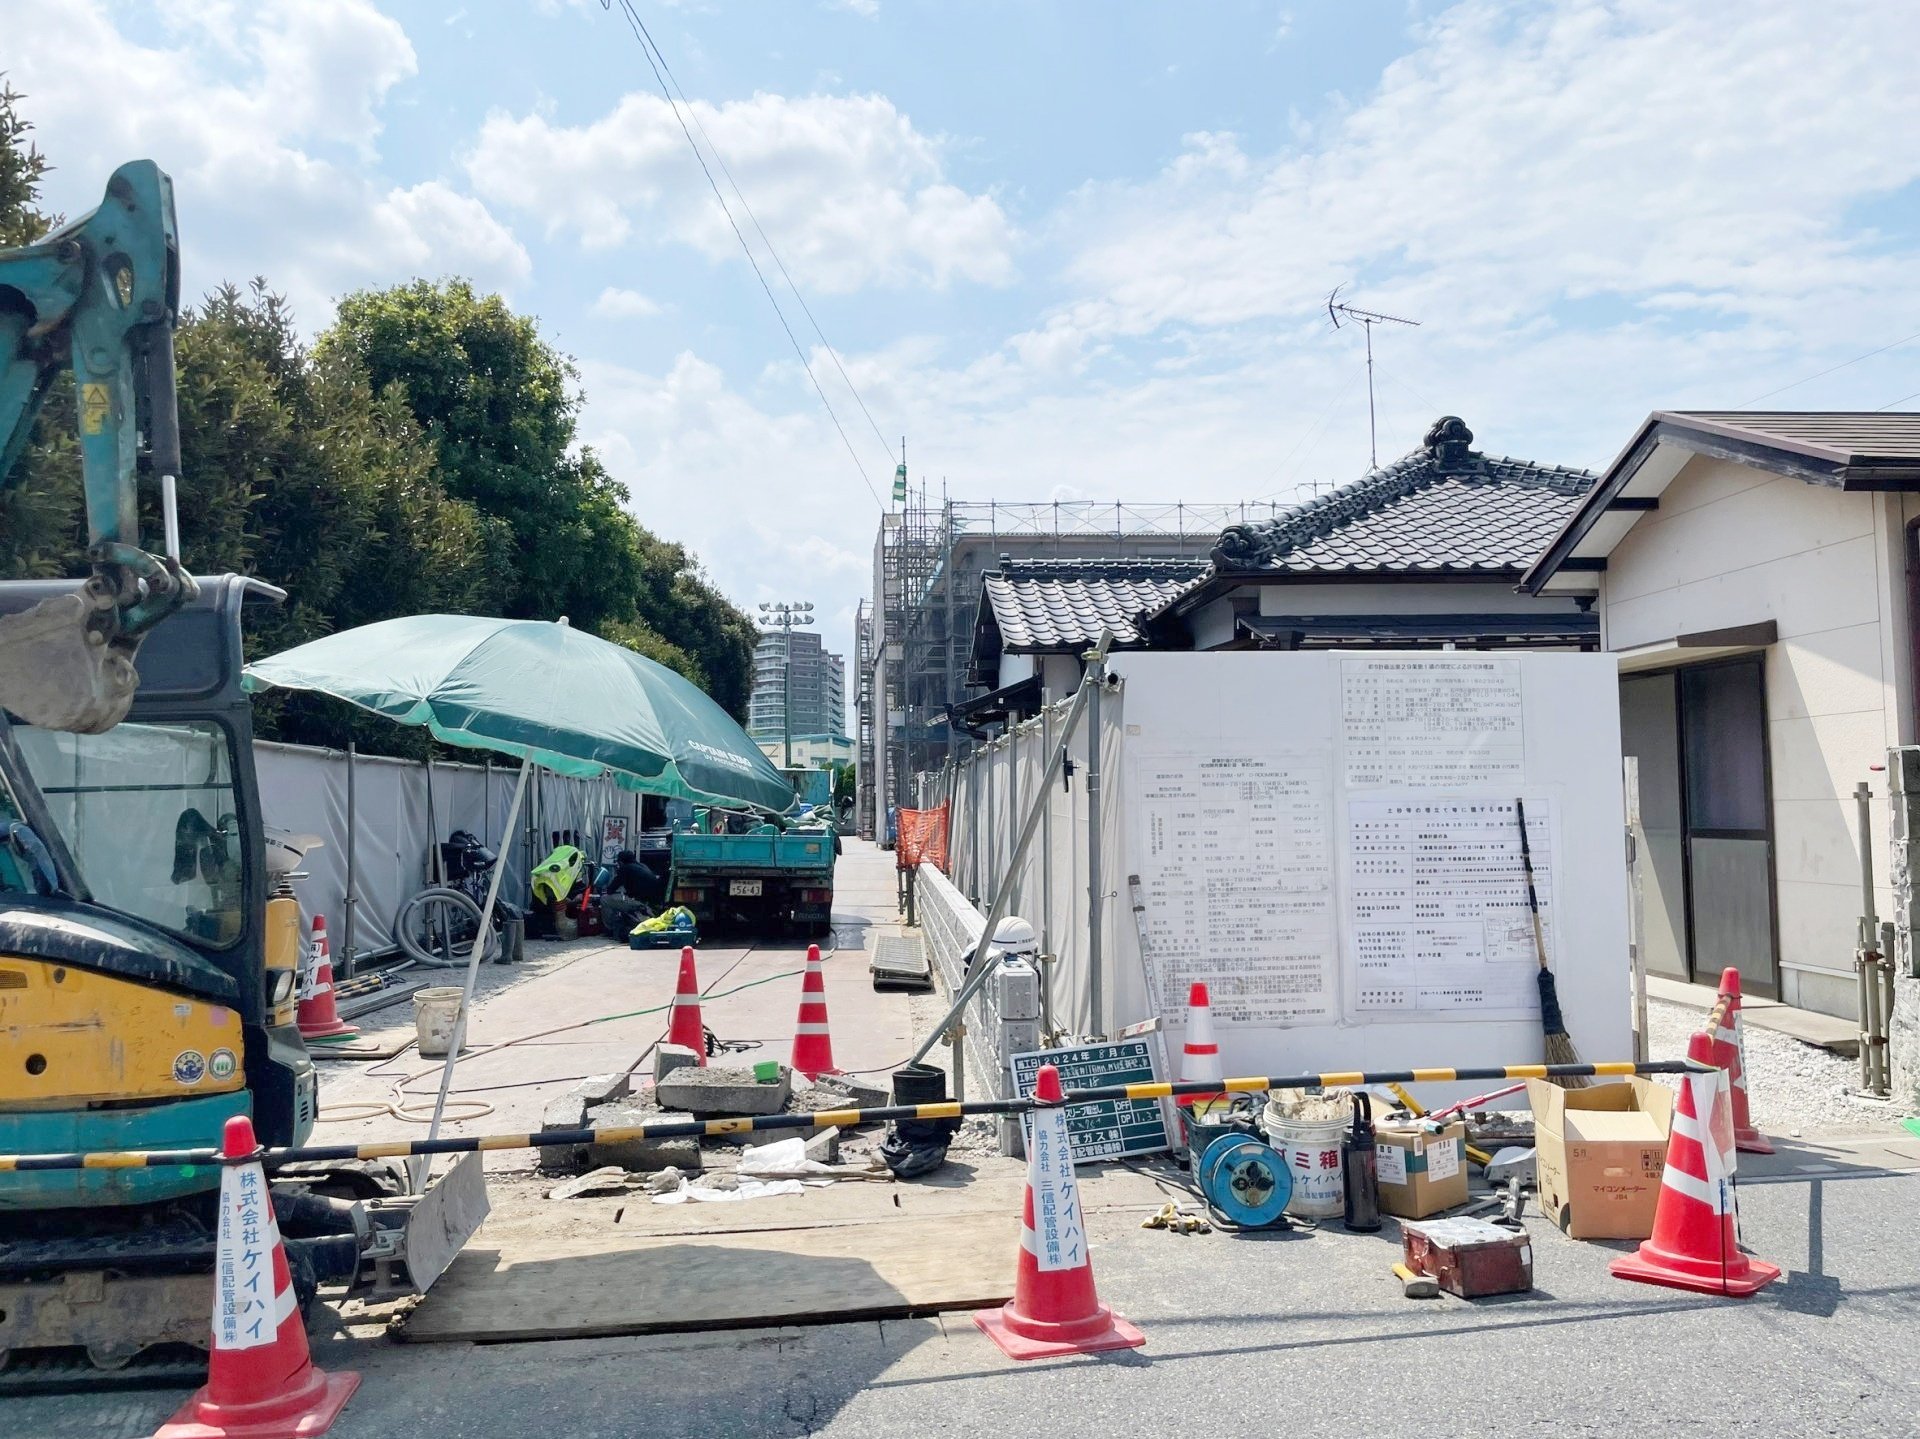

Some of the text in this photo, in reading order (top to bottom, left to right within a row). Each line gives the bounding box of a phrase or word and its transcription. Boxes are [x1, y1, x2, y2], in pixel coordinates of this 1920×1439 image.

[1116, 1101, 1130, 1111] OFF
[1120, 1114, 1131, 1124] DP
[1038, 1129, 1051, 1173] 協力会社
[1055, 1112, 1079, 1263] 株式会社ケイハイ
[1592, 1185, 1648, 1194] マイコンメーター
[240, 1171, 265, 1340] 株式会社ケイハイ
